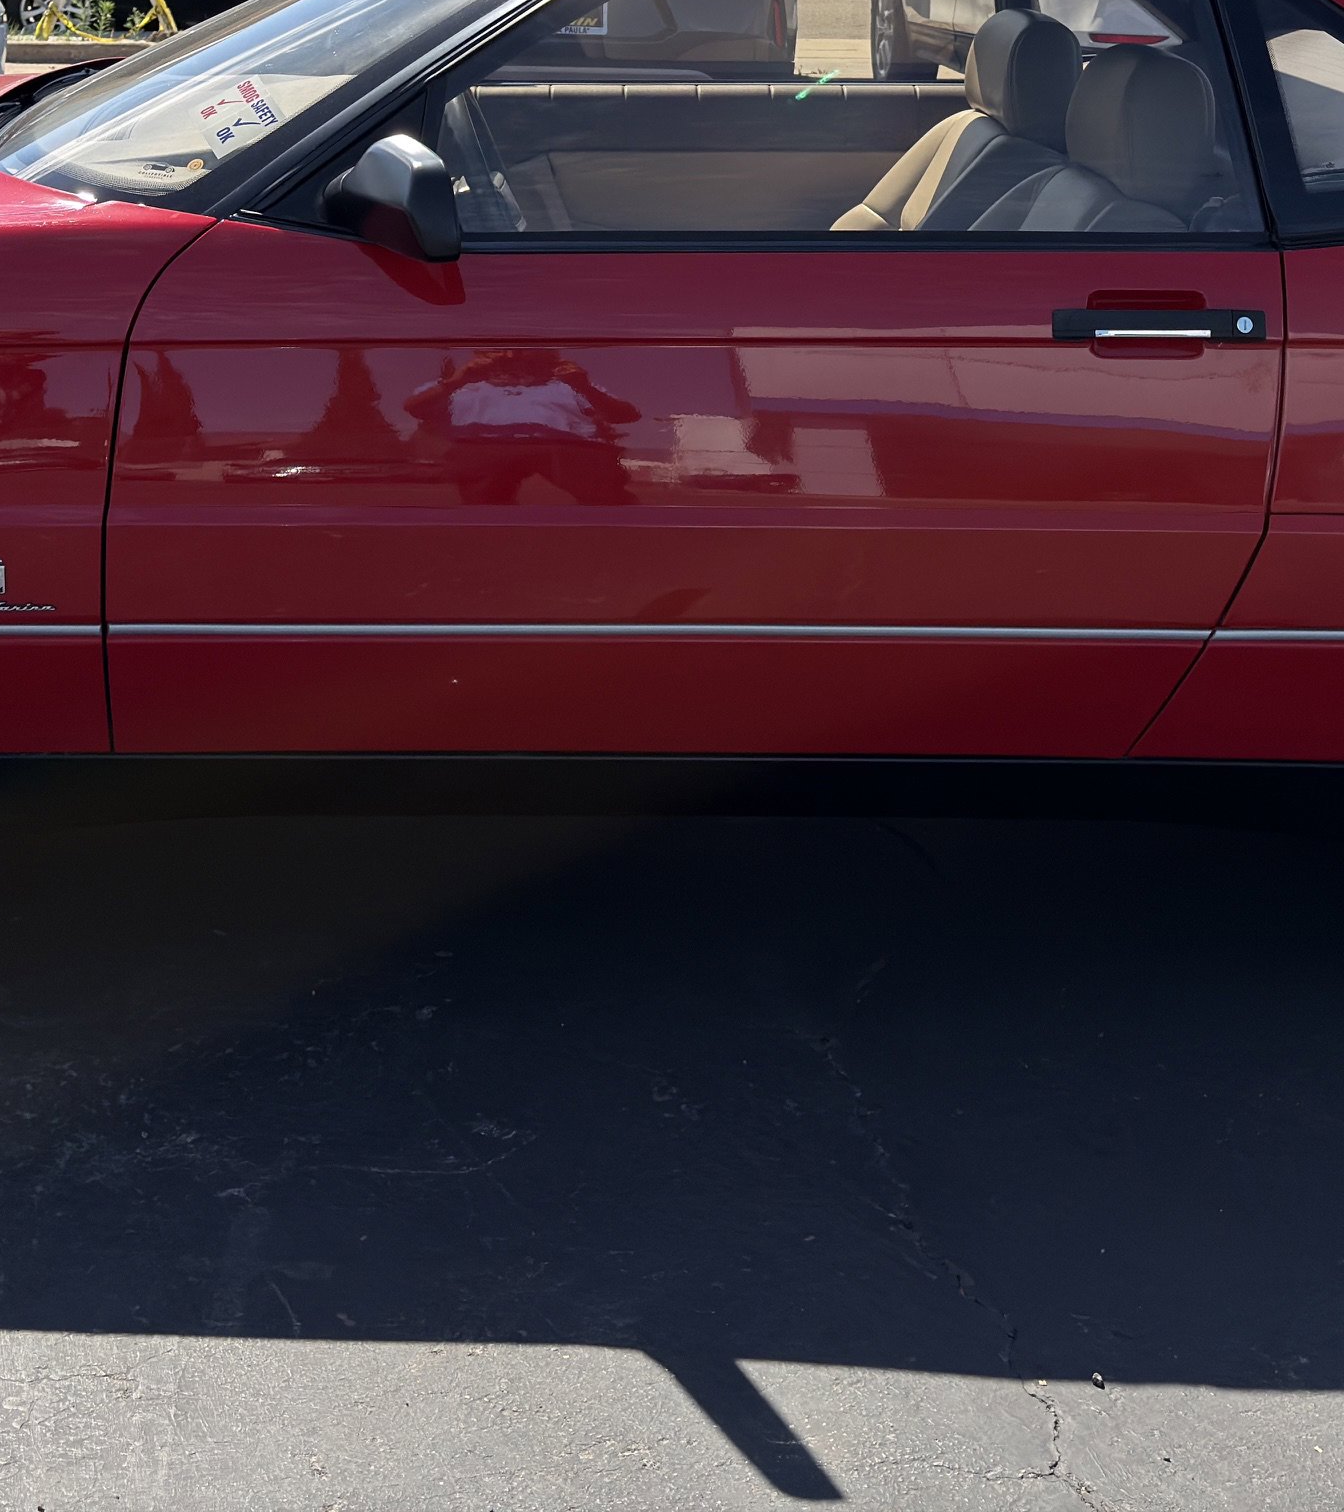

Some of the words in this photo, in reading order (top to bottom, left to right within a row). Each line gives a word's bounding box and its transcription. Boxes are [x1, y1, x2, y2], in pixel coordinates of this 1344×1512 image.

[237, 80, 260, 104] SMOG
[200, 105, 218, 120] OK
[250, 98, 279, 127] SAFETY
[216, 126, 236, 145] OK
